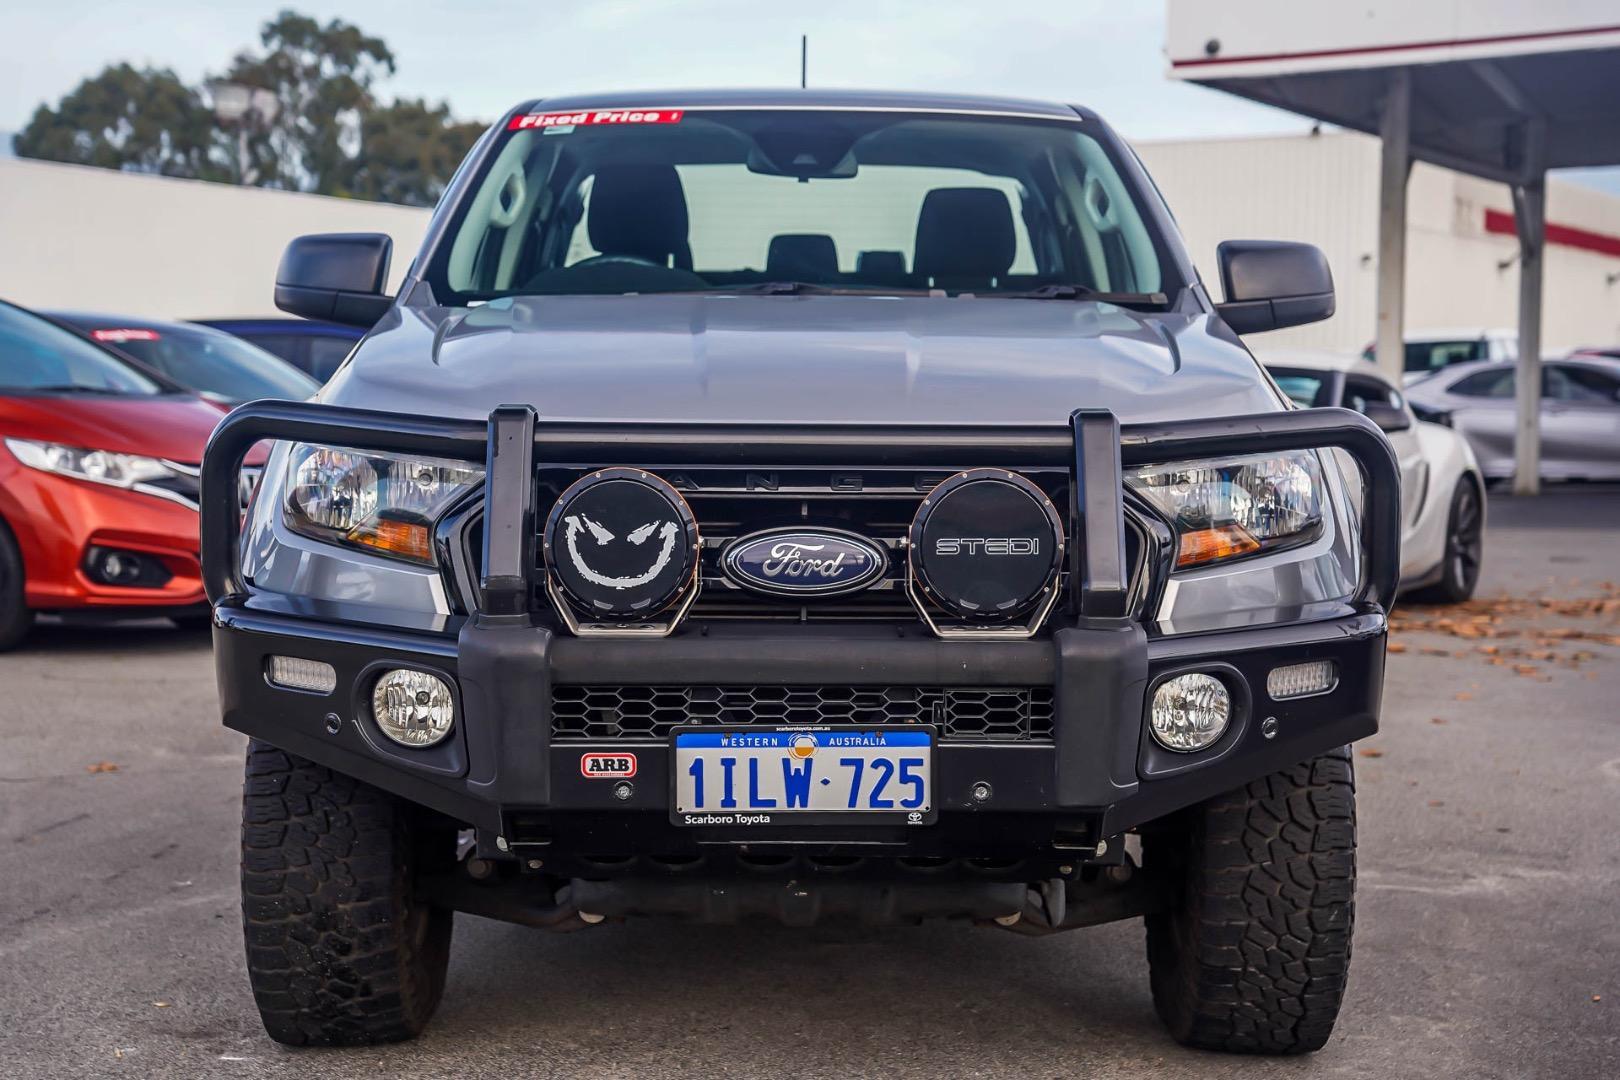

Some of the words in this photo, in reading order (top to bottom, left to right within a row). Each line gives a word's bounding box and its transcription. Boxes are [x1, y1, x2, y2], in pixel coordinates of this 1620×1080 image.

[518, 113, 588, 128] Fixed
[592, 111, 660, 124] Price
[936, 538, 1039, 555] STEDI
[762, 542, 846, 577] Ford
[721, 738, 778, 747] WESTERN
[829, 737, 887, 746] AUSTRALIA
[588, 758, 630, 772] ARB
[684, 814, 733, 824] Scarboro
[735, 814, 771, 825] Toyota
